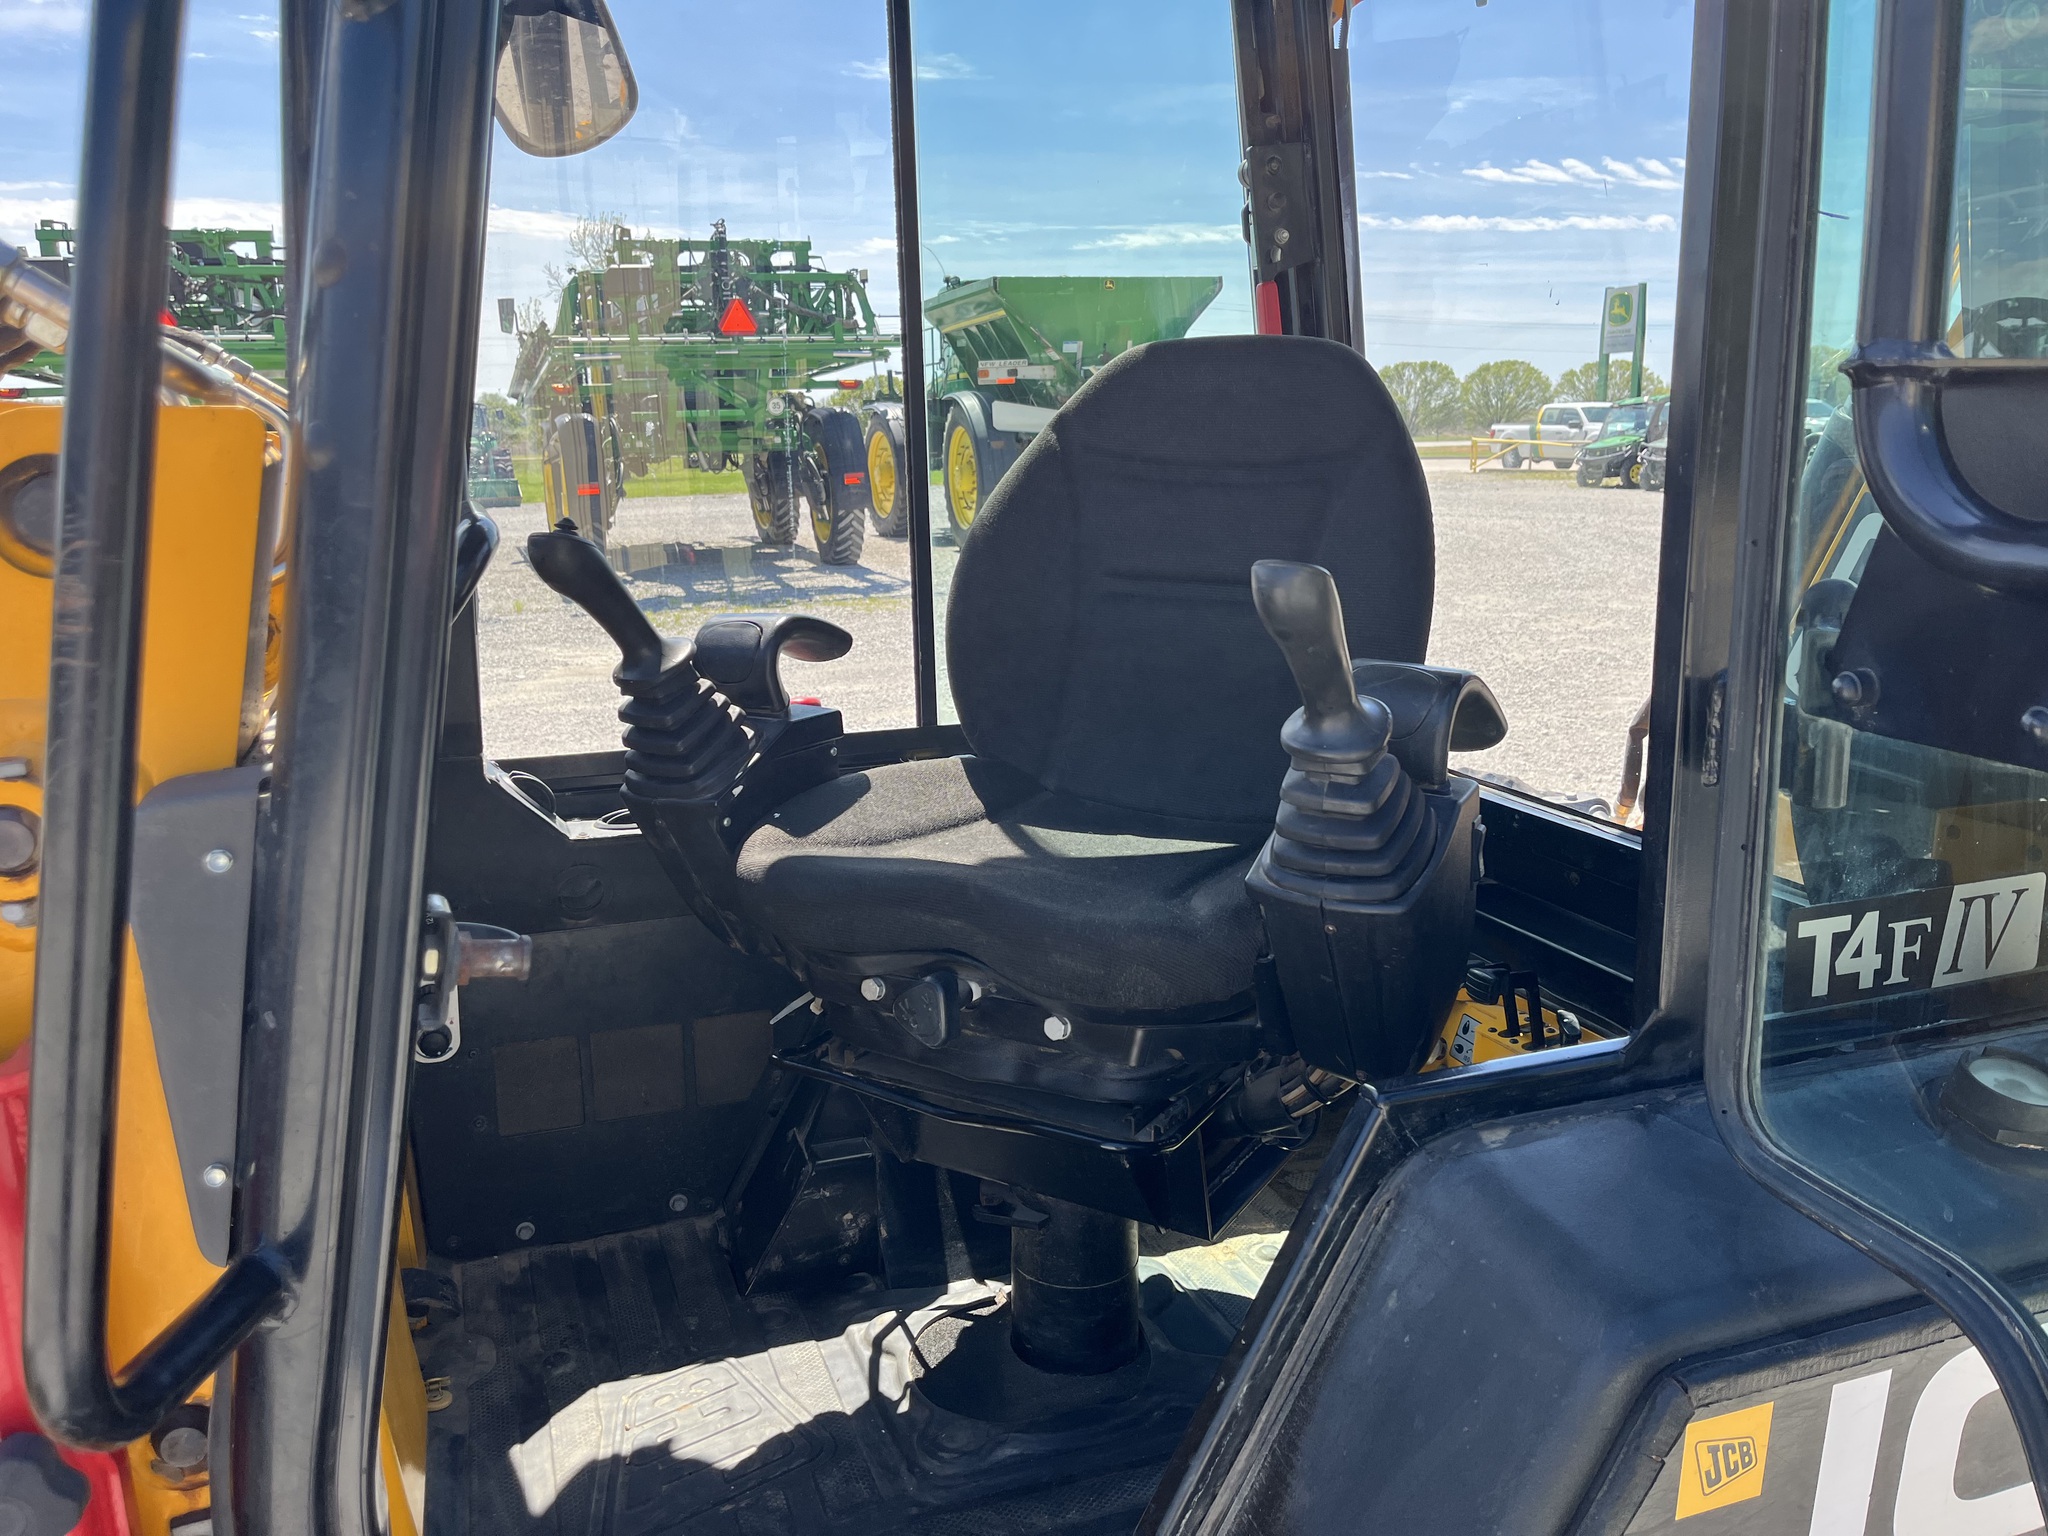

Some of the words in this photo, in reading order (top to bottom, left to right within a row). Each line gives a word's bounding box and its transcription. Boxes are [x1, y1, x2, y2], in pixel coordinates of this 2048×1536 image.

[1797, 910, 1932, 997] T4F
[1942, 887, 2030, 975] IV
[1704, 1441, 1753, 1489] JCB
